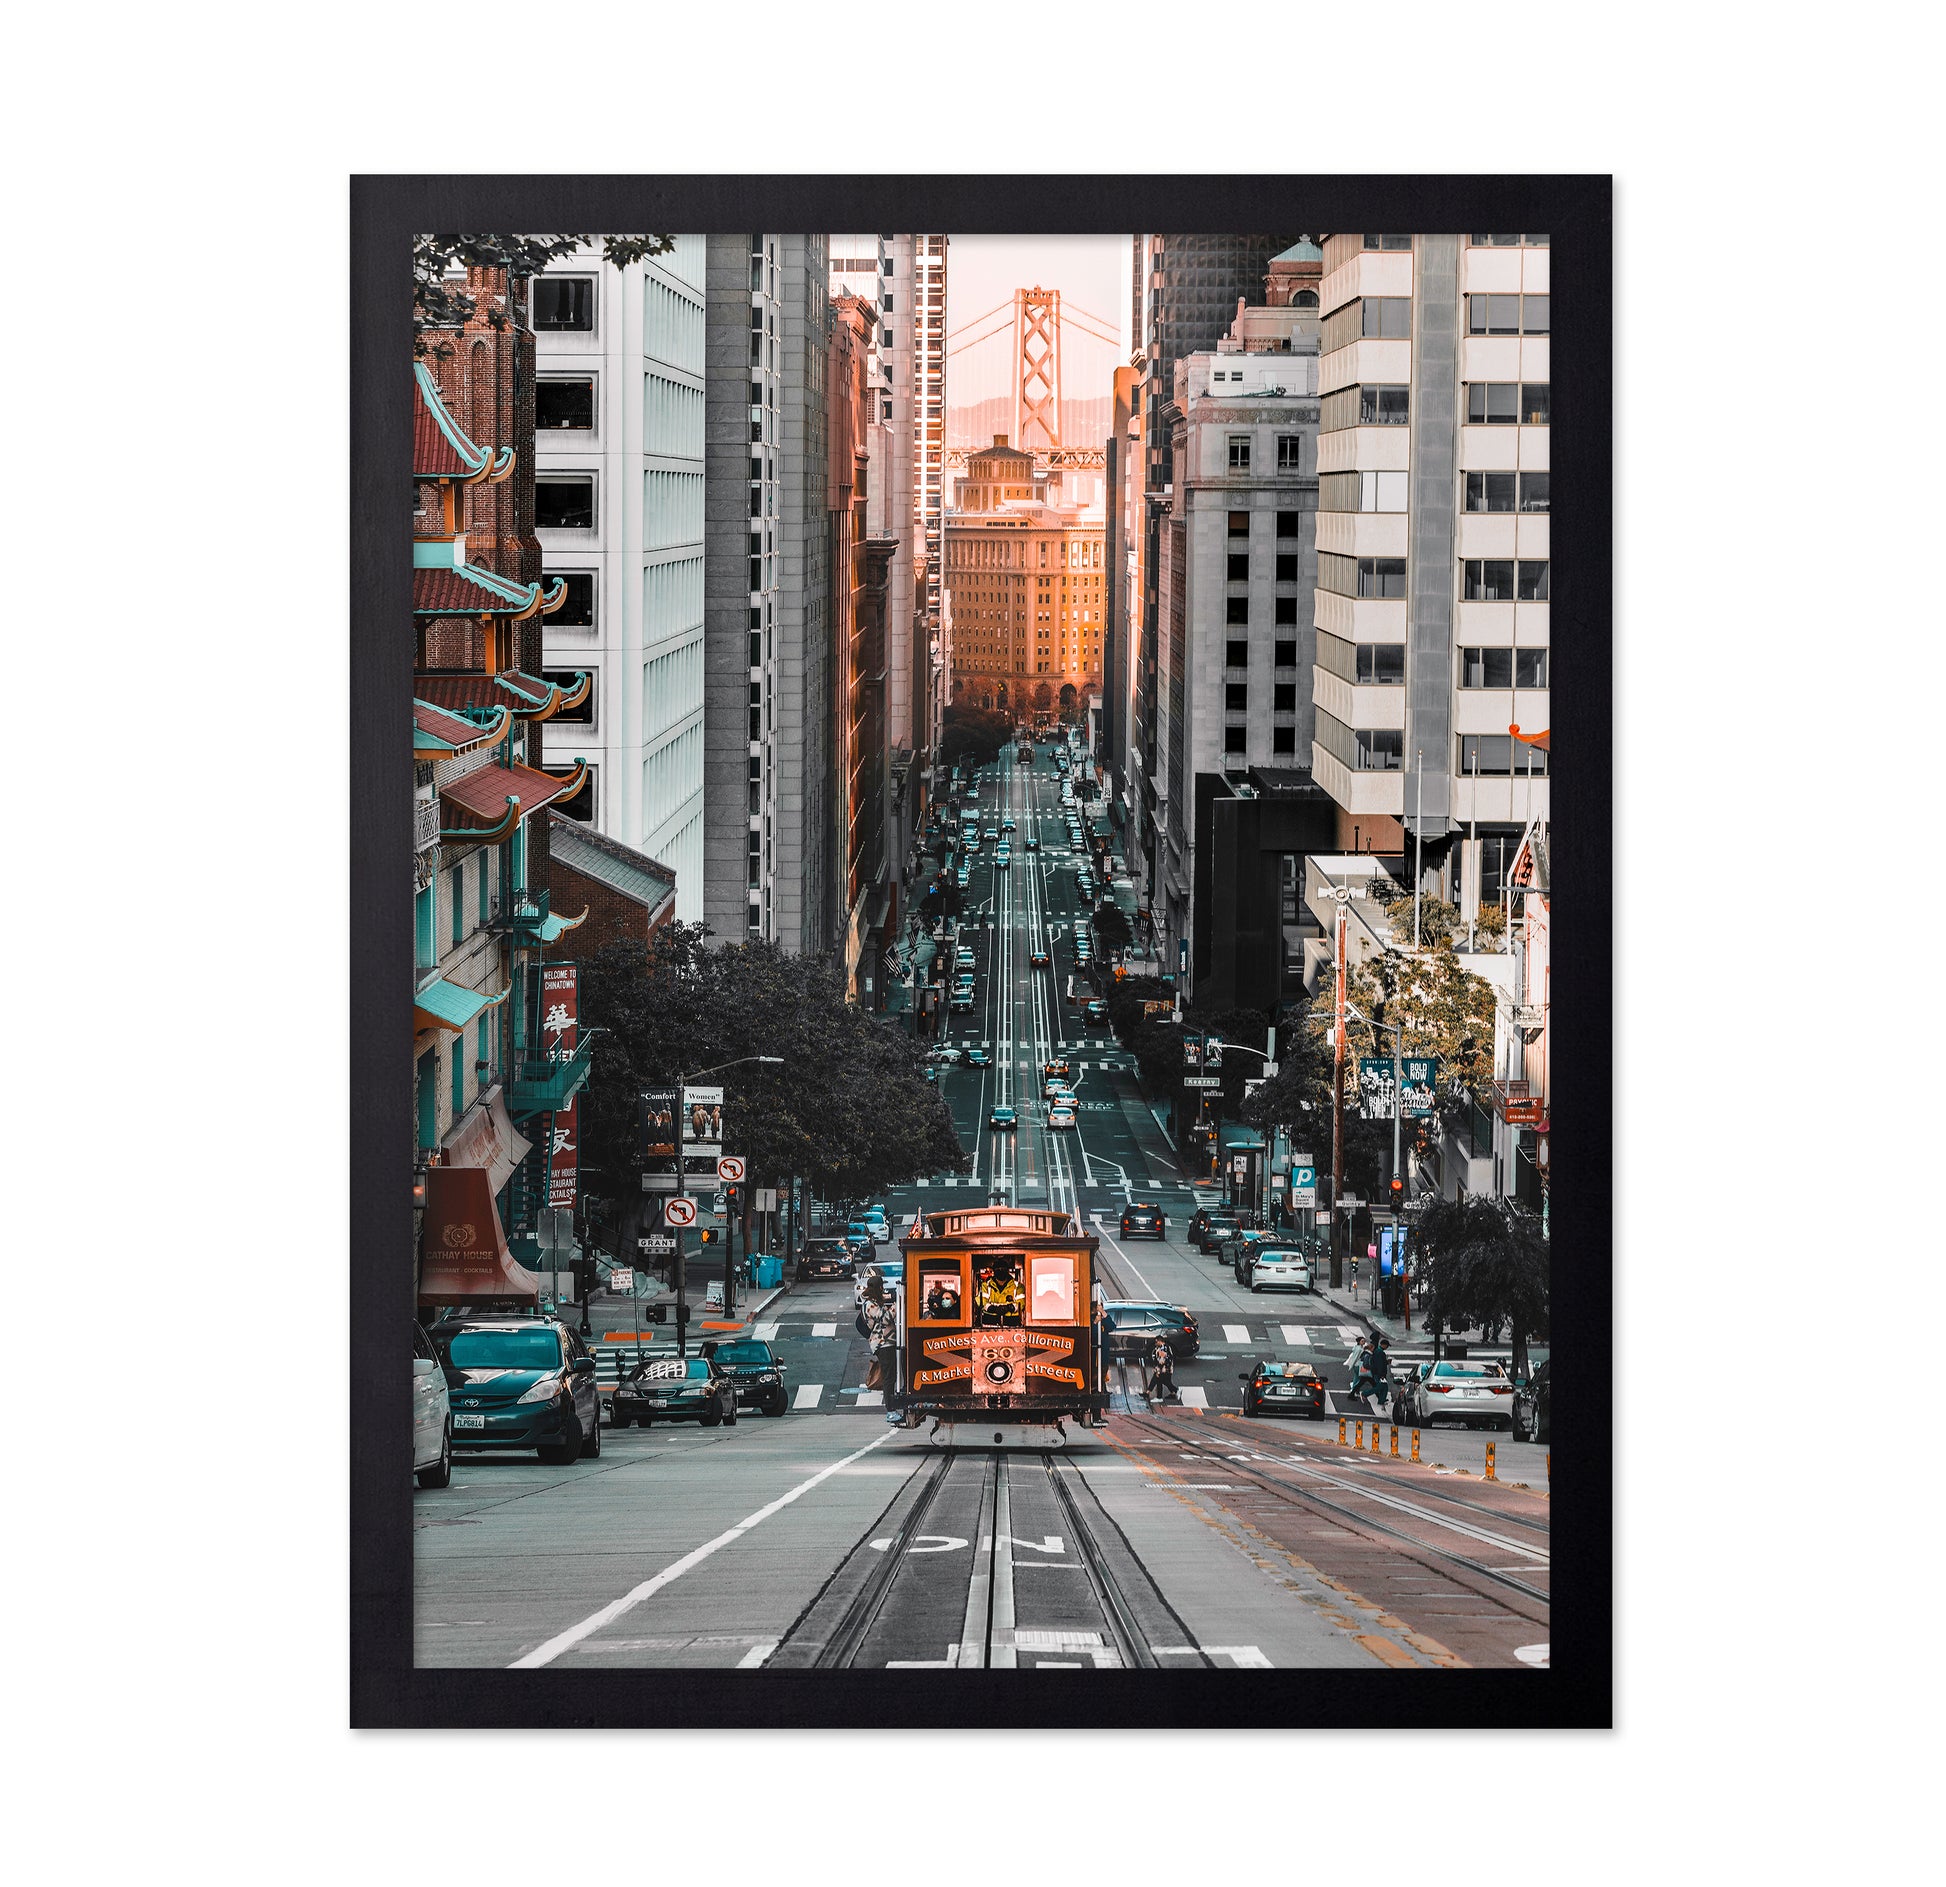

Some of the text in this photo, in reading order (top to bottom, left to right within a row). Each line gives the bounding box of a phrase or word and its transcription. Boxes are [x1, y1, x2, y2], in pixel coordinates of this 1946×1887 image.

[543, 969, 577, 980] WELCOME TO
[544, 980, 575, 990] CHINATOWN
[1409, 1063, 1428, 1072] BOLD
[1409, 1071, 1428, 1080] NOW
[1368, 1096, 1386, 1106] BOLD
[561, 1167, 577, 1178] HOUSE
[546, 1178, 577, 1189] STAURANT
[546, 1189, 572, 1199] CKTAILS
[426, 1251, 494, 1260] CATHAY HOUSE
[926, 1340, 947, 1351] Van
[947, 1335, 977, 1347] Ness
[1013, 1333, 1073, 1350] California
[983, 1347, 1014, 1360] 60
[920, 1363, 1076, 1382] & Market Streets
